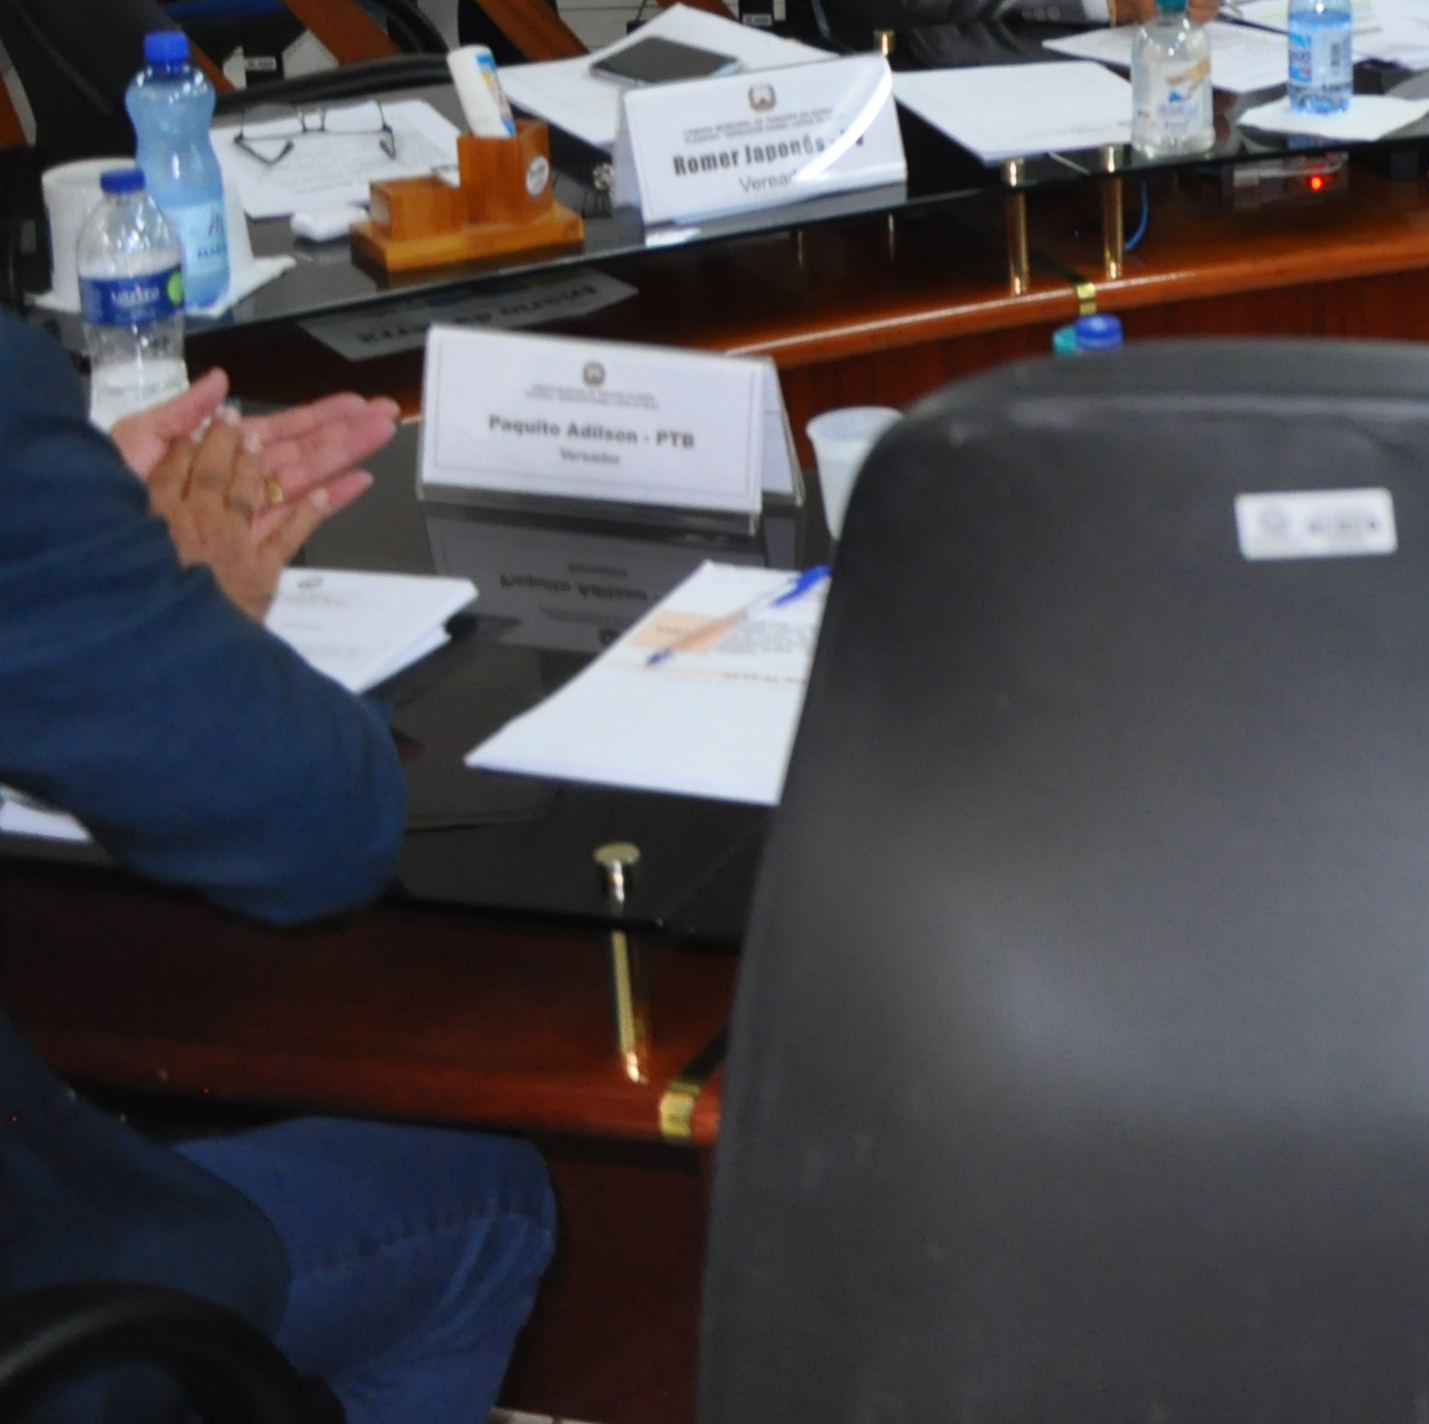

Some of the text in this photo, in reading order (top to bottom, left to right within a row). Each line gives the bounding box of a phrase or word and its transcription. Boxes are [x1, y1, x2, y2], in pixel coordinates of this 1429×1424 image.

[672, 149, 740, 176] Romer
[745, 133, 827, 165] Japonês
[488, 413, 561, 438] Paquito
[567, 422, 638, 444] Adilson
[656, 430, 695, 450] PTB
[559, 446, 621, 465] Vereador
